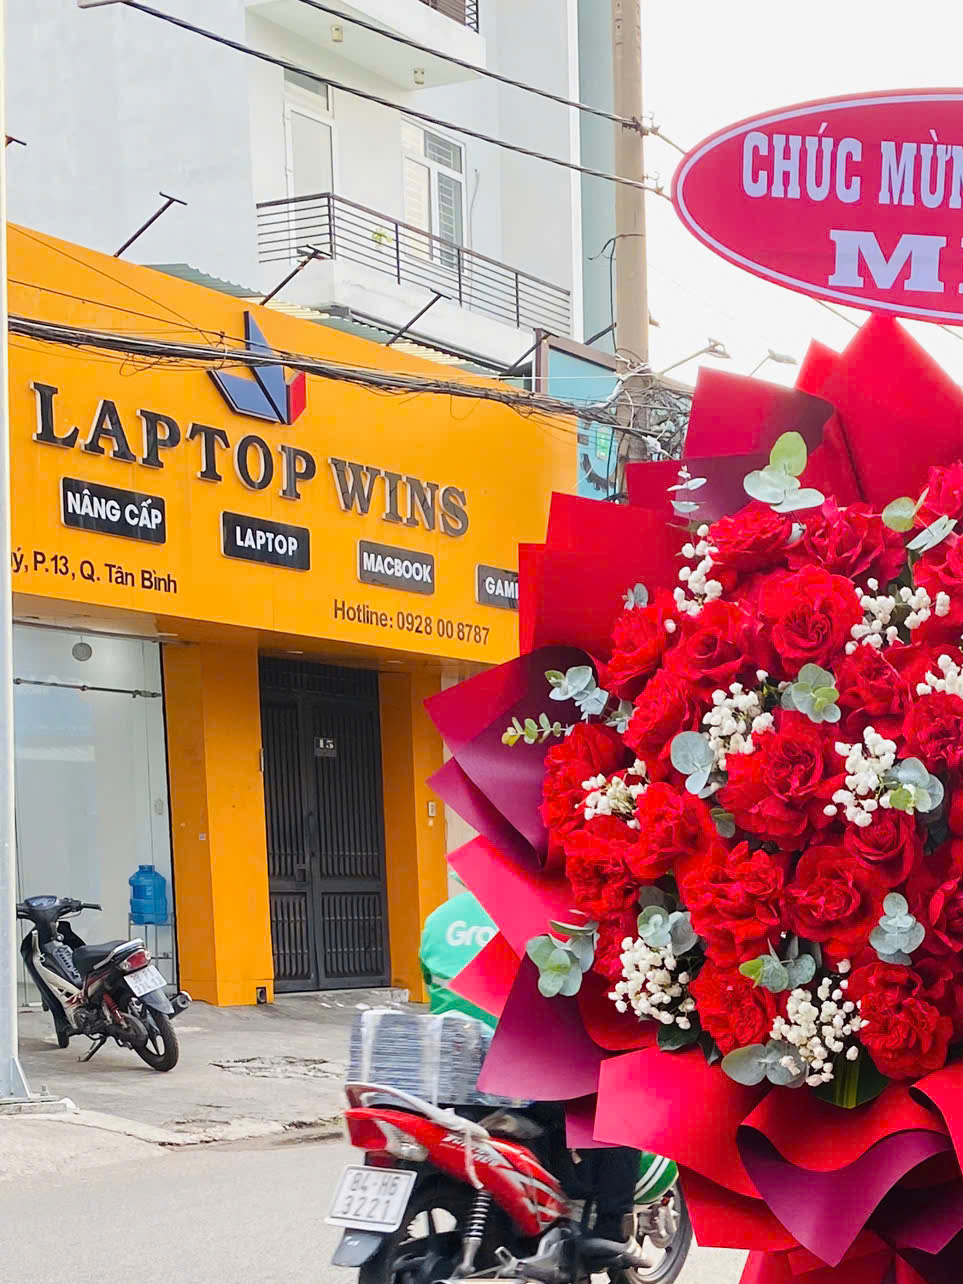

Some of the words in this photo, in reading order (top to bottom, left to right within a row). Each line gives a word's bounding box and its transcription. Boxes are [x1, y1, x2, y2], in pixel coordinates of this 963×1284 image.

[742, 122, 862, 202] CHÚC
[30, 382, 317, 500] LAPTOP
[329, 457, 469, 537] WINS
[67, 489, 121, 522] NÂNG
[124, 499, 163, 530] CẤP
[235, 525, 299, 557] LAPTOP
[80, 560, 100, 582] Q.
[104, 563, 135, 587] Tân
[141, 570, 177, 594] Bình
[362, 551, 433, 584] MACBOOK
[485, 576, 519, 600] GAMI
[334, 598, 393, 629] Hotline:
[396, 611, 433, 636] 0928
[437, 619, 454, 639] 00
[456, 624, 490, 646] 8787
